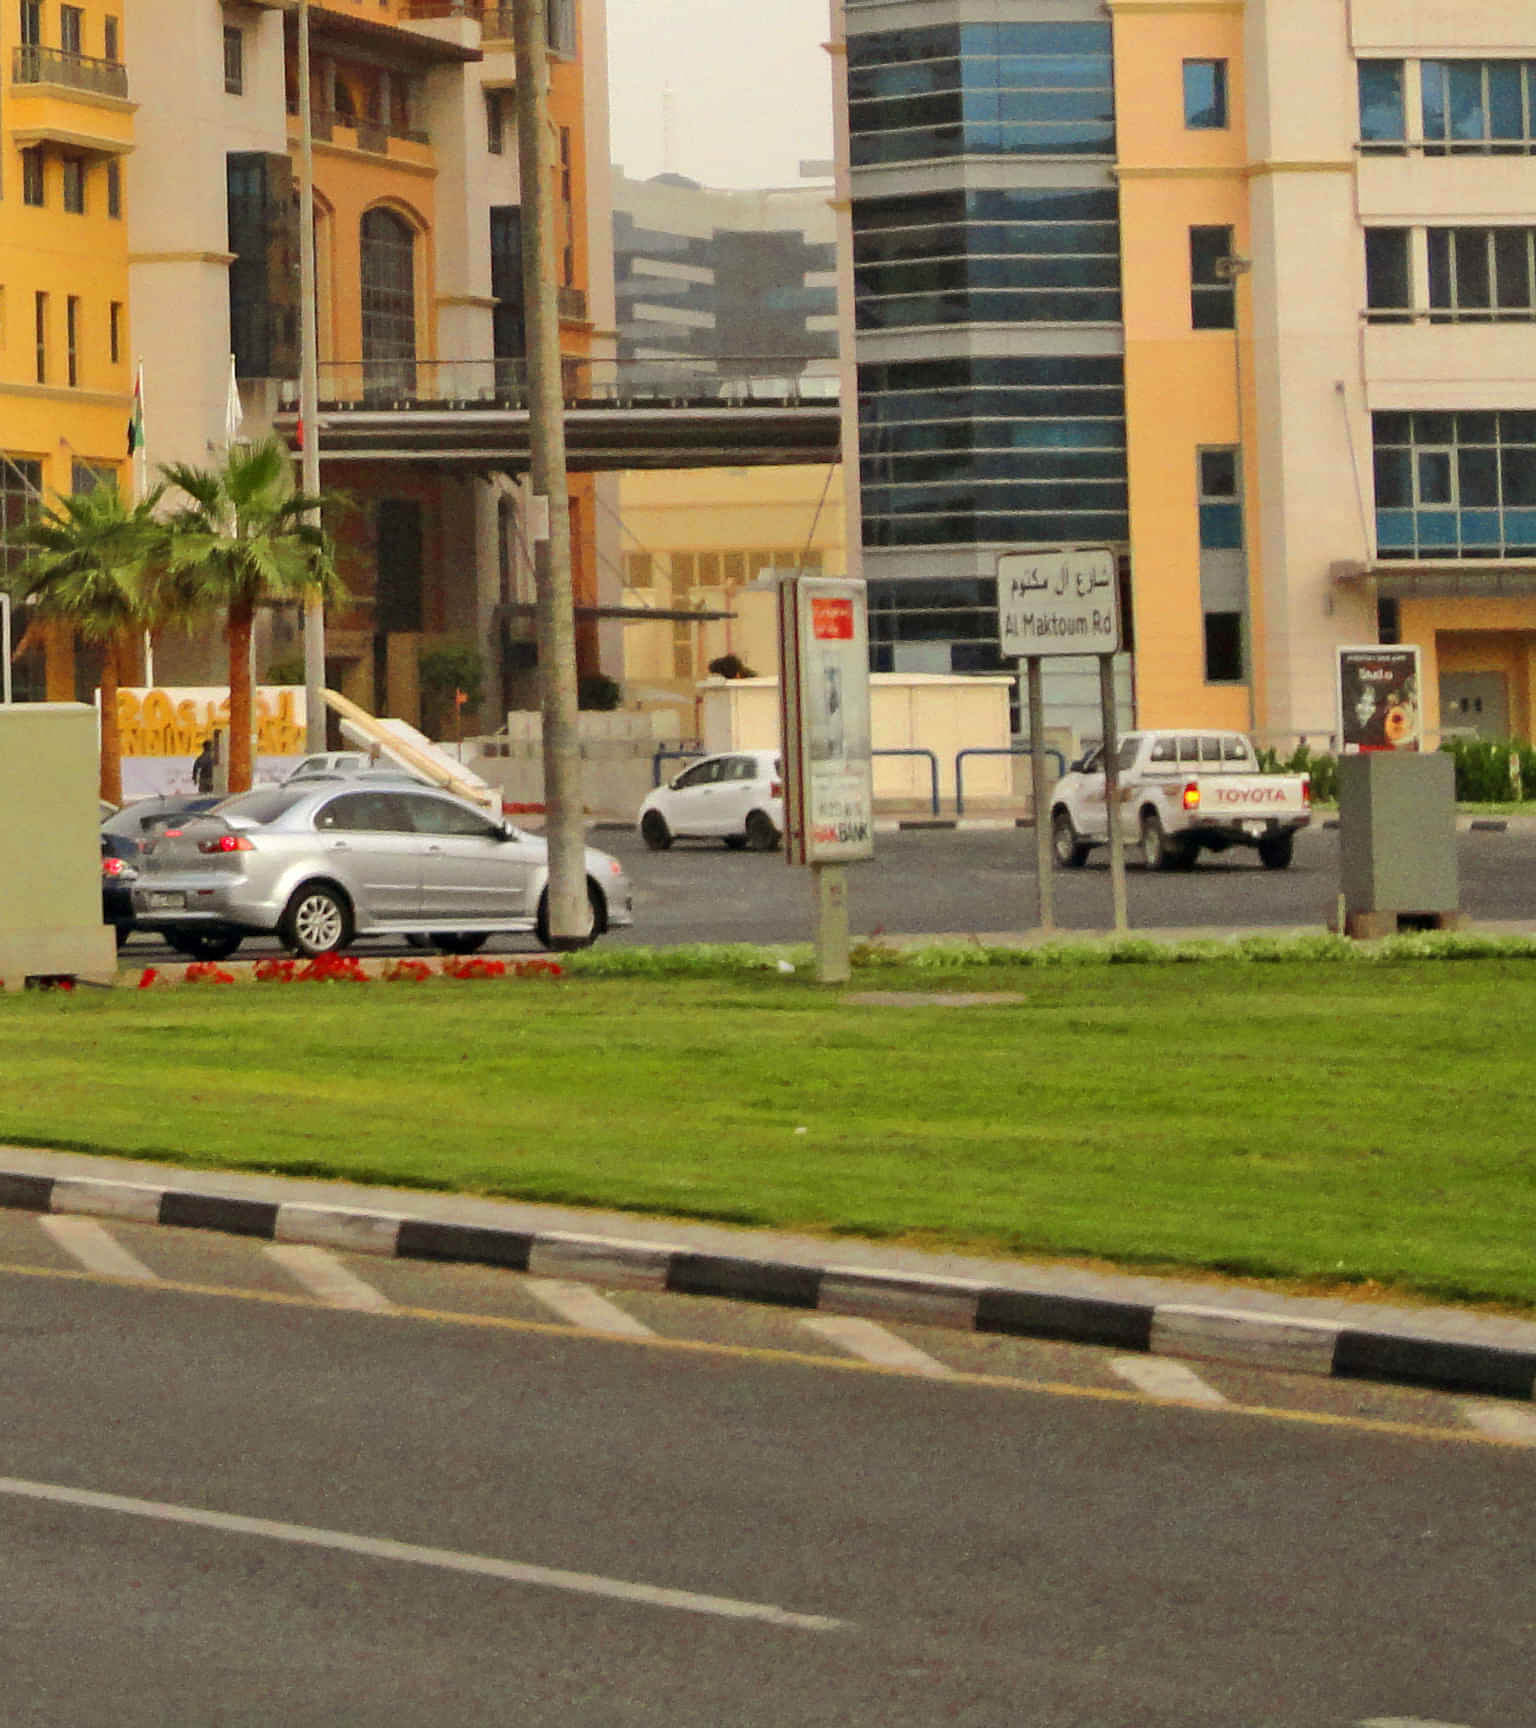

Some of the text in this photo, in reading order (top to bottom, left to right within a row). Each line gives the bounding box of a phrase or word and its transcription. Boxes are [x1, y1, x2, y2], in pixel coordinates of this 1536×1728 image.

[1011, 567, 1049, 600] مكتوم
[1006, 609, 1112, 636] Al Maktoum Rd
[1216, 788, 1287, 803] TOYOTA
